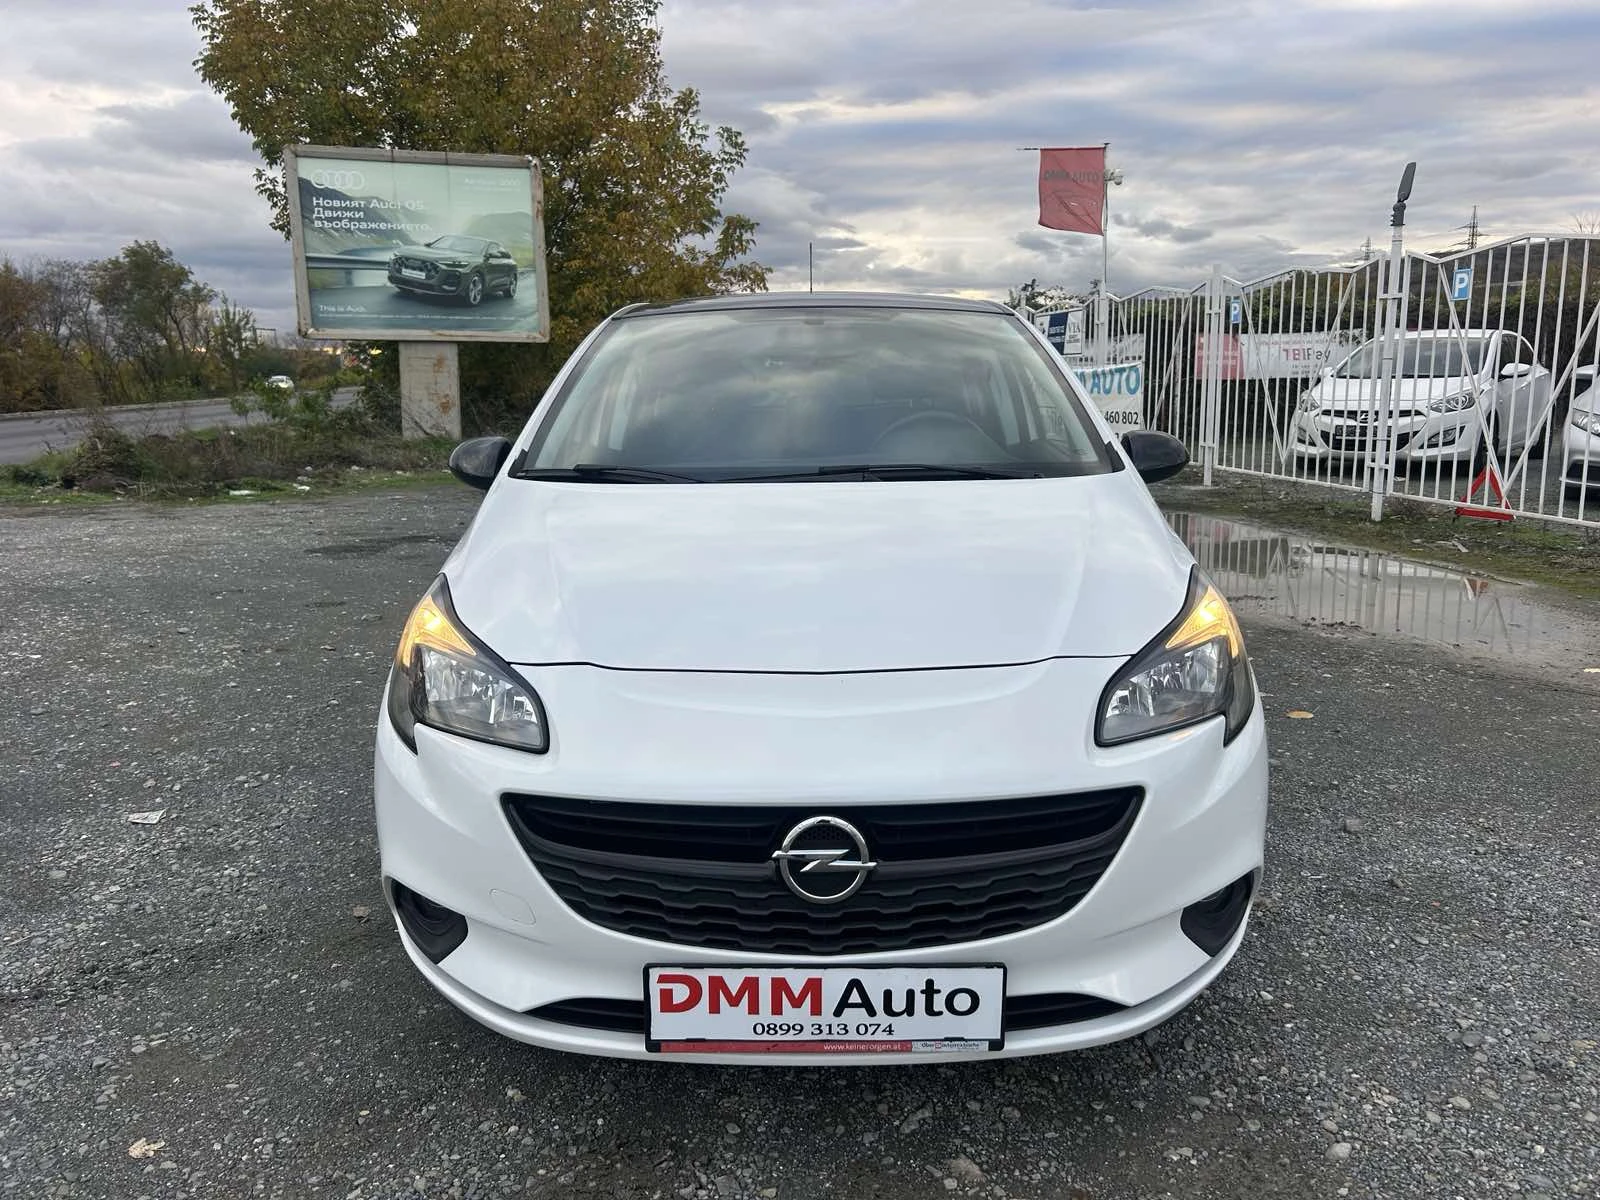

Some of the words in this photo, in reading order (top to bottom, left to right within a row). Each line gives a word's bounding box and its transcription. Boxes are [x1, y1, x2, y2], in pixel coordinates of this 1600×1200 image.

[312, 196, 366, 209] Новият
[369, 198, 401, 210] Audi
[312, 207, 365, 219] Движи
[1454, 272, 1469, 298] P
[1231, 302, 1240, 321] P
[1090, 366, 1141, 395] AUTO
[1121, 411, 1139, 425] 802
[656, 974, 824, 1017] DMM
[832, 978, 981, 1018] Auto
[752, 1022, 805, 1037] 0899
[810, 1022, 850, 1037] 313
[855, 1022, 896, 1037] 074
